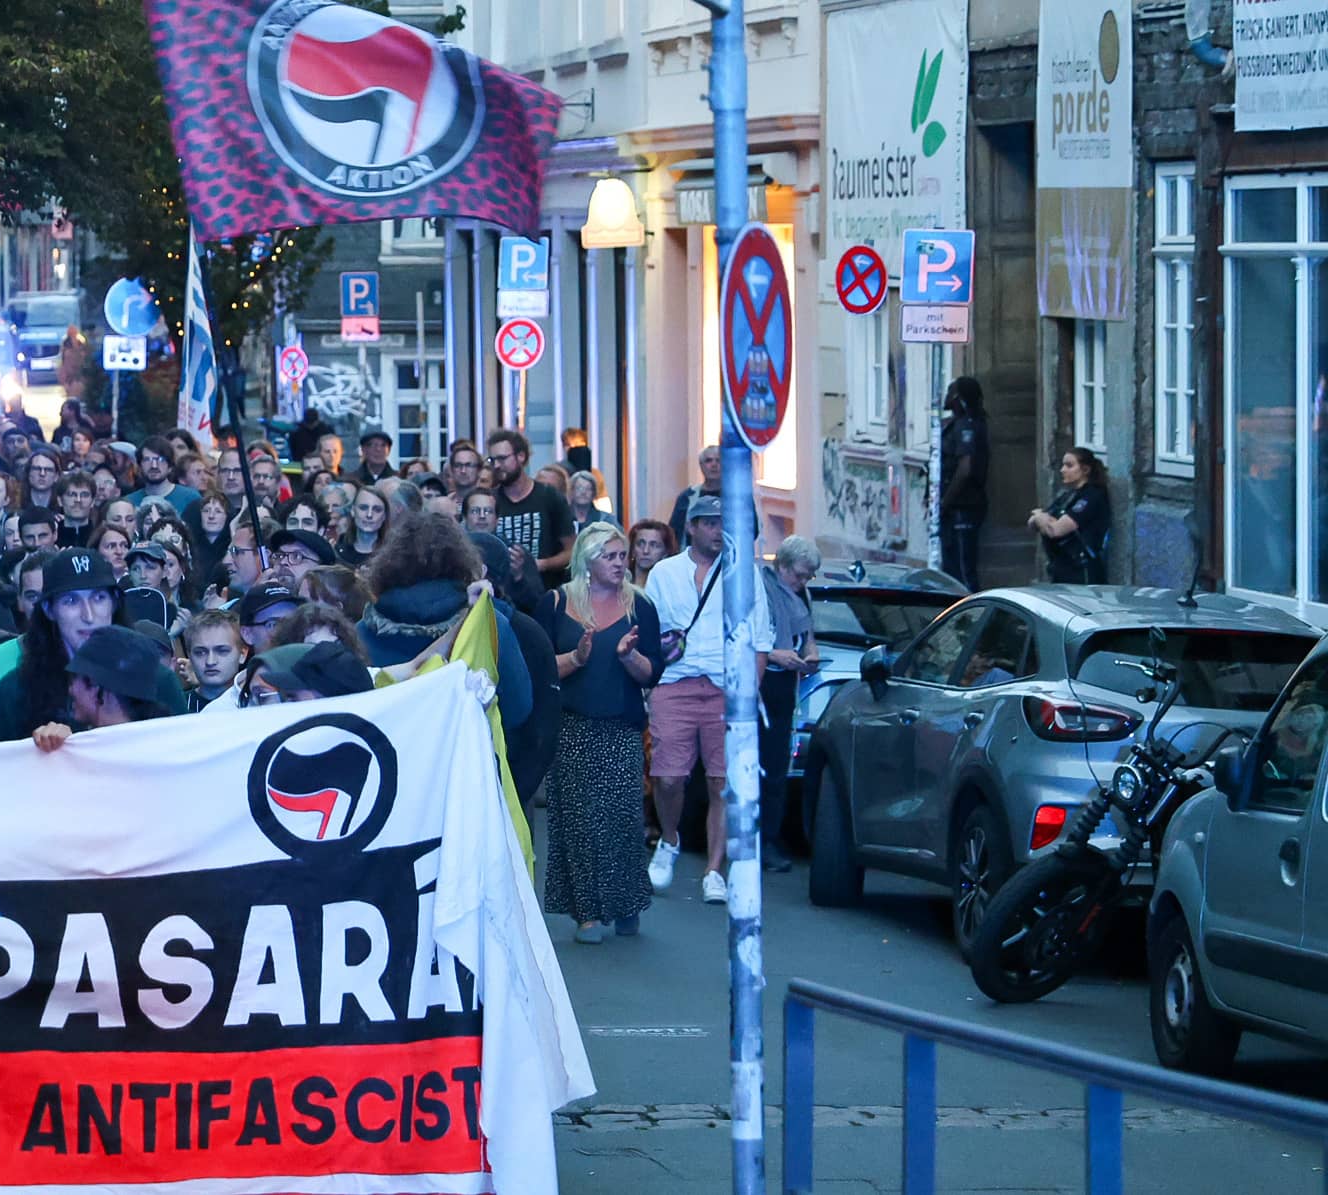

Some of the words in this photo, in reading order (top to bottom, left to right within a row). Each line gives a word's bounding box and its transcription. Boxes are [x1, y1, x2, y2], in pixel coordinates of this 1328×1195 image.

[1052, 69, 1110, 150] porde
[326, 155, 435, 188] AKTION
[511, 244, 536, 283] P
[349, 278, 369, 311] P
[906, 324, 965, 334] Parkschein
[926, 313, 943, 321] mit
